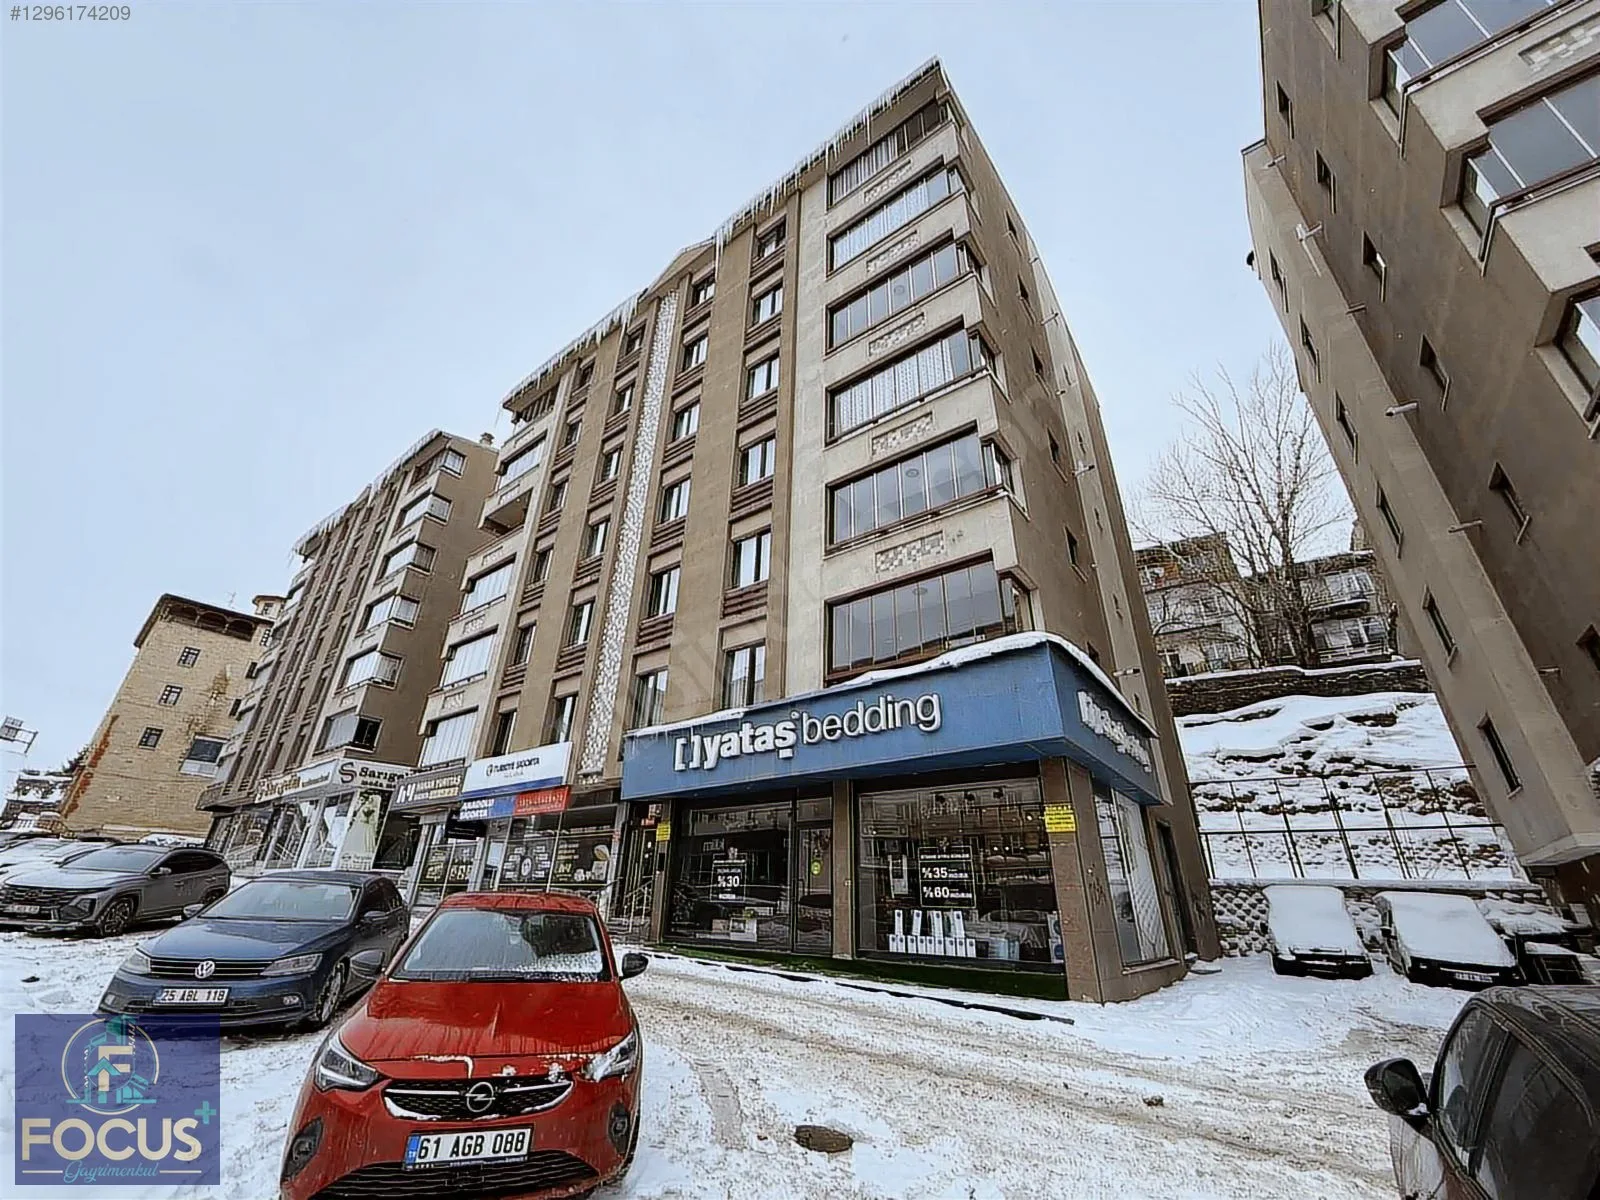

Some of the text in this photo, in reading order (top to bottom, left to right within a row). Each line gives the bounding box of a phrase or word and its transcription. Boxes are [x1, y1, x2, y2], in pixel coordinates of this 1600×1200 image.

[802, 693, 941, 746] bedding
[717, 875, 740, 888] %30
[922, 866, 948, 879] %35
[418, 1131, 526, 1160] 61 AGB 088
